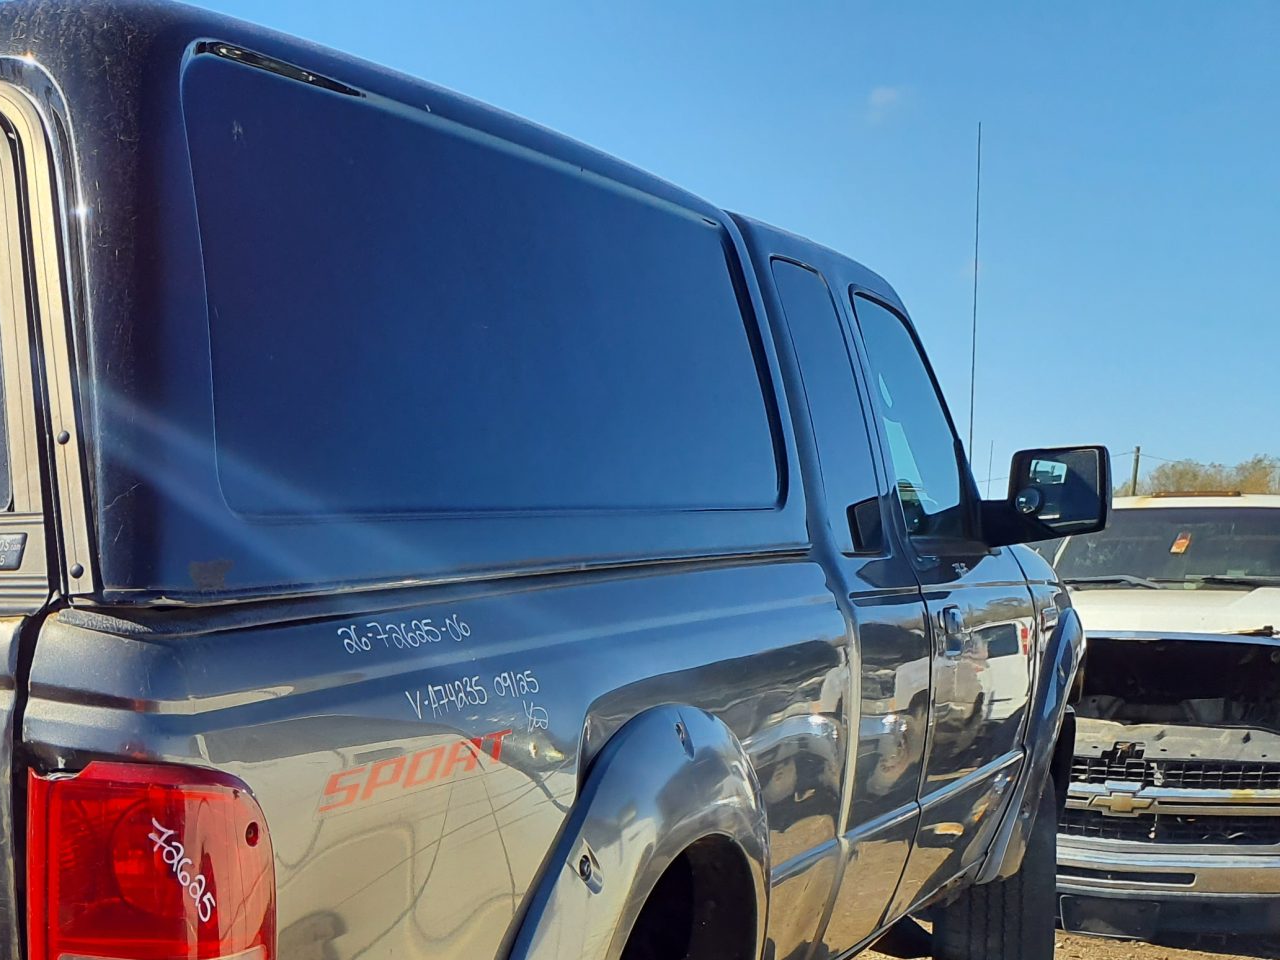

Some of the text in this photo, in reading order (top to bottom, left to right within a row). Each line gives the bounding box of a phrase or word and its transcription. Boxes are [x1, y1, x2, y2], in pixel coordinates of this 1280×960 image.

[337, 613, 471, 655] 26-72625-06
[318, 728, 513, 814] SPORT
[147, 816, 217, 923] 72625
